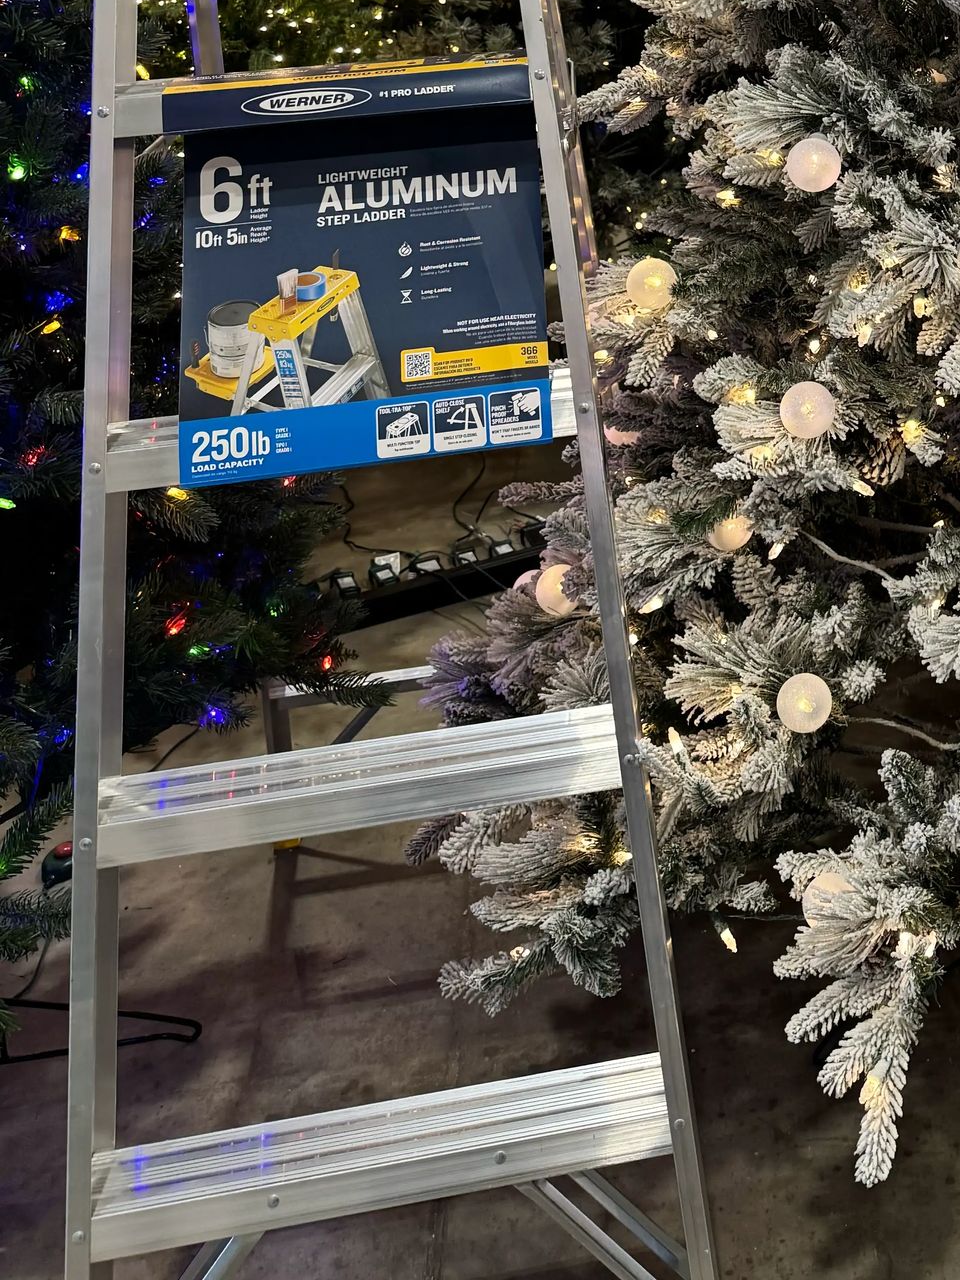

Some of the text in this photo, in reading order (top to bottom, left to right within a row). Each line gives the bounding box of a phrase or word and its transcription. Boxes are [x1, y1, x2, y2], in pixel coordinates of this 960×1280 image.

[390, 88, 413, 98] PRO
[268, 93, 347, 110] WERNER
[318, 166, 408, 184] LIGHTWEIGHT
[318, 167, 518, 214] ALUMINUM
[316, 208, 406, 228] STEP LADDER
[196, 228, 248, 248] 10ft 5in
[420, 263, 448, 272] Lightweight
[520, 346, 538, 356] 366
[436, 399, 464, 408] AUTO-CLOSE
[492, 416, 520, 425] SPREADERS
[192, 426, 270, 464] 250lb
[192, 458, 264, 473] LOAD CAPACITY
